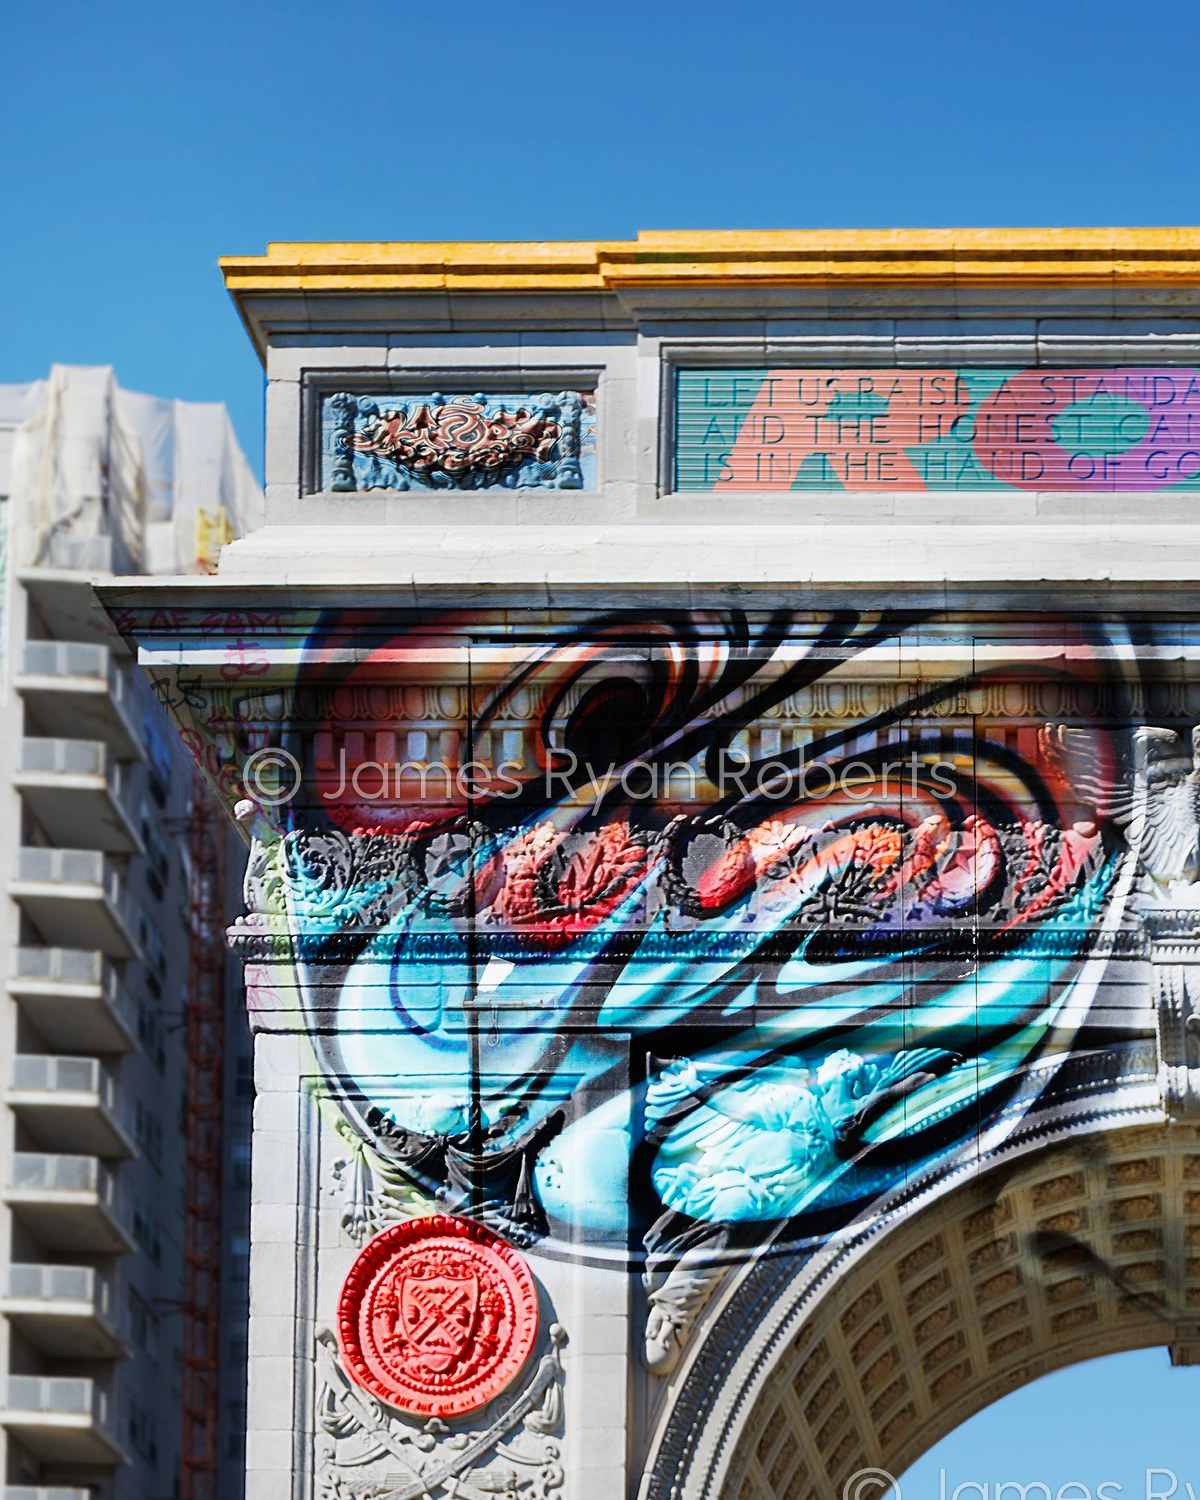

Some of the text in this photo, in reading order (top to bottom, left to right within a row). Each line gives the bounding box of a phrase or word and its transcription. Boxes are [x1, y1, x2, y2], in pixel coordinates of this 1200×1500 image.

[704, 377, 783, 407] LET
[798, 377, 842, 407] US
[858, 376, 976, 406] RAISE
[992, 376, 1019, 406] A
[701, 415, 785, 444] AND
[805, 414, 891, 444] THE
[918, 413, 1092, 444] HONEST
[704, 452, 734, 481] IS
[756, 451, 792, 481] IN
[812, 451, 899, 481] THE
[924, 451, 1045, 481] HAND
[1067, 451, 1126, 480] OF
